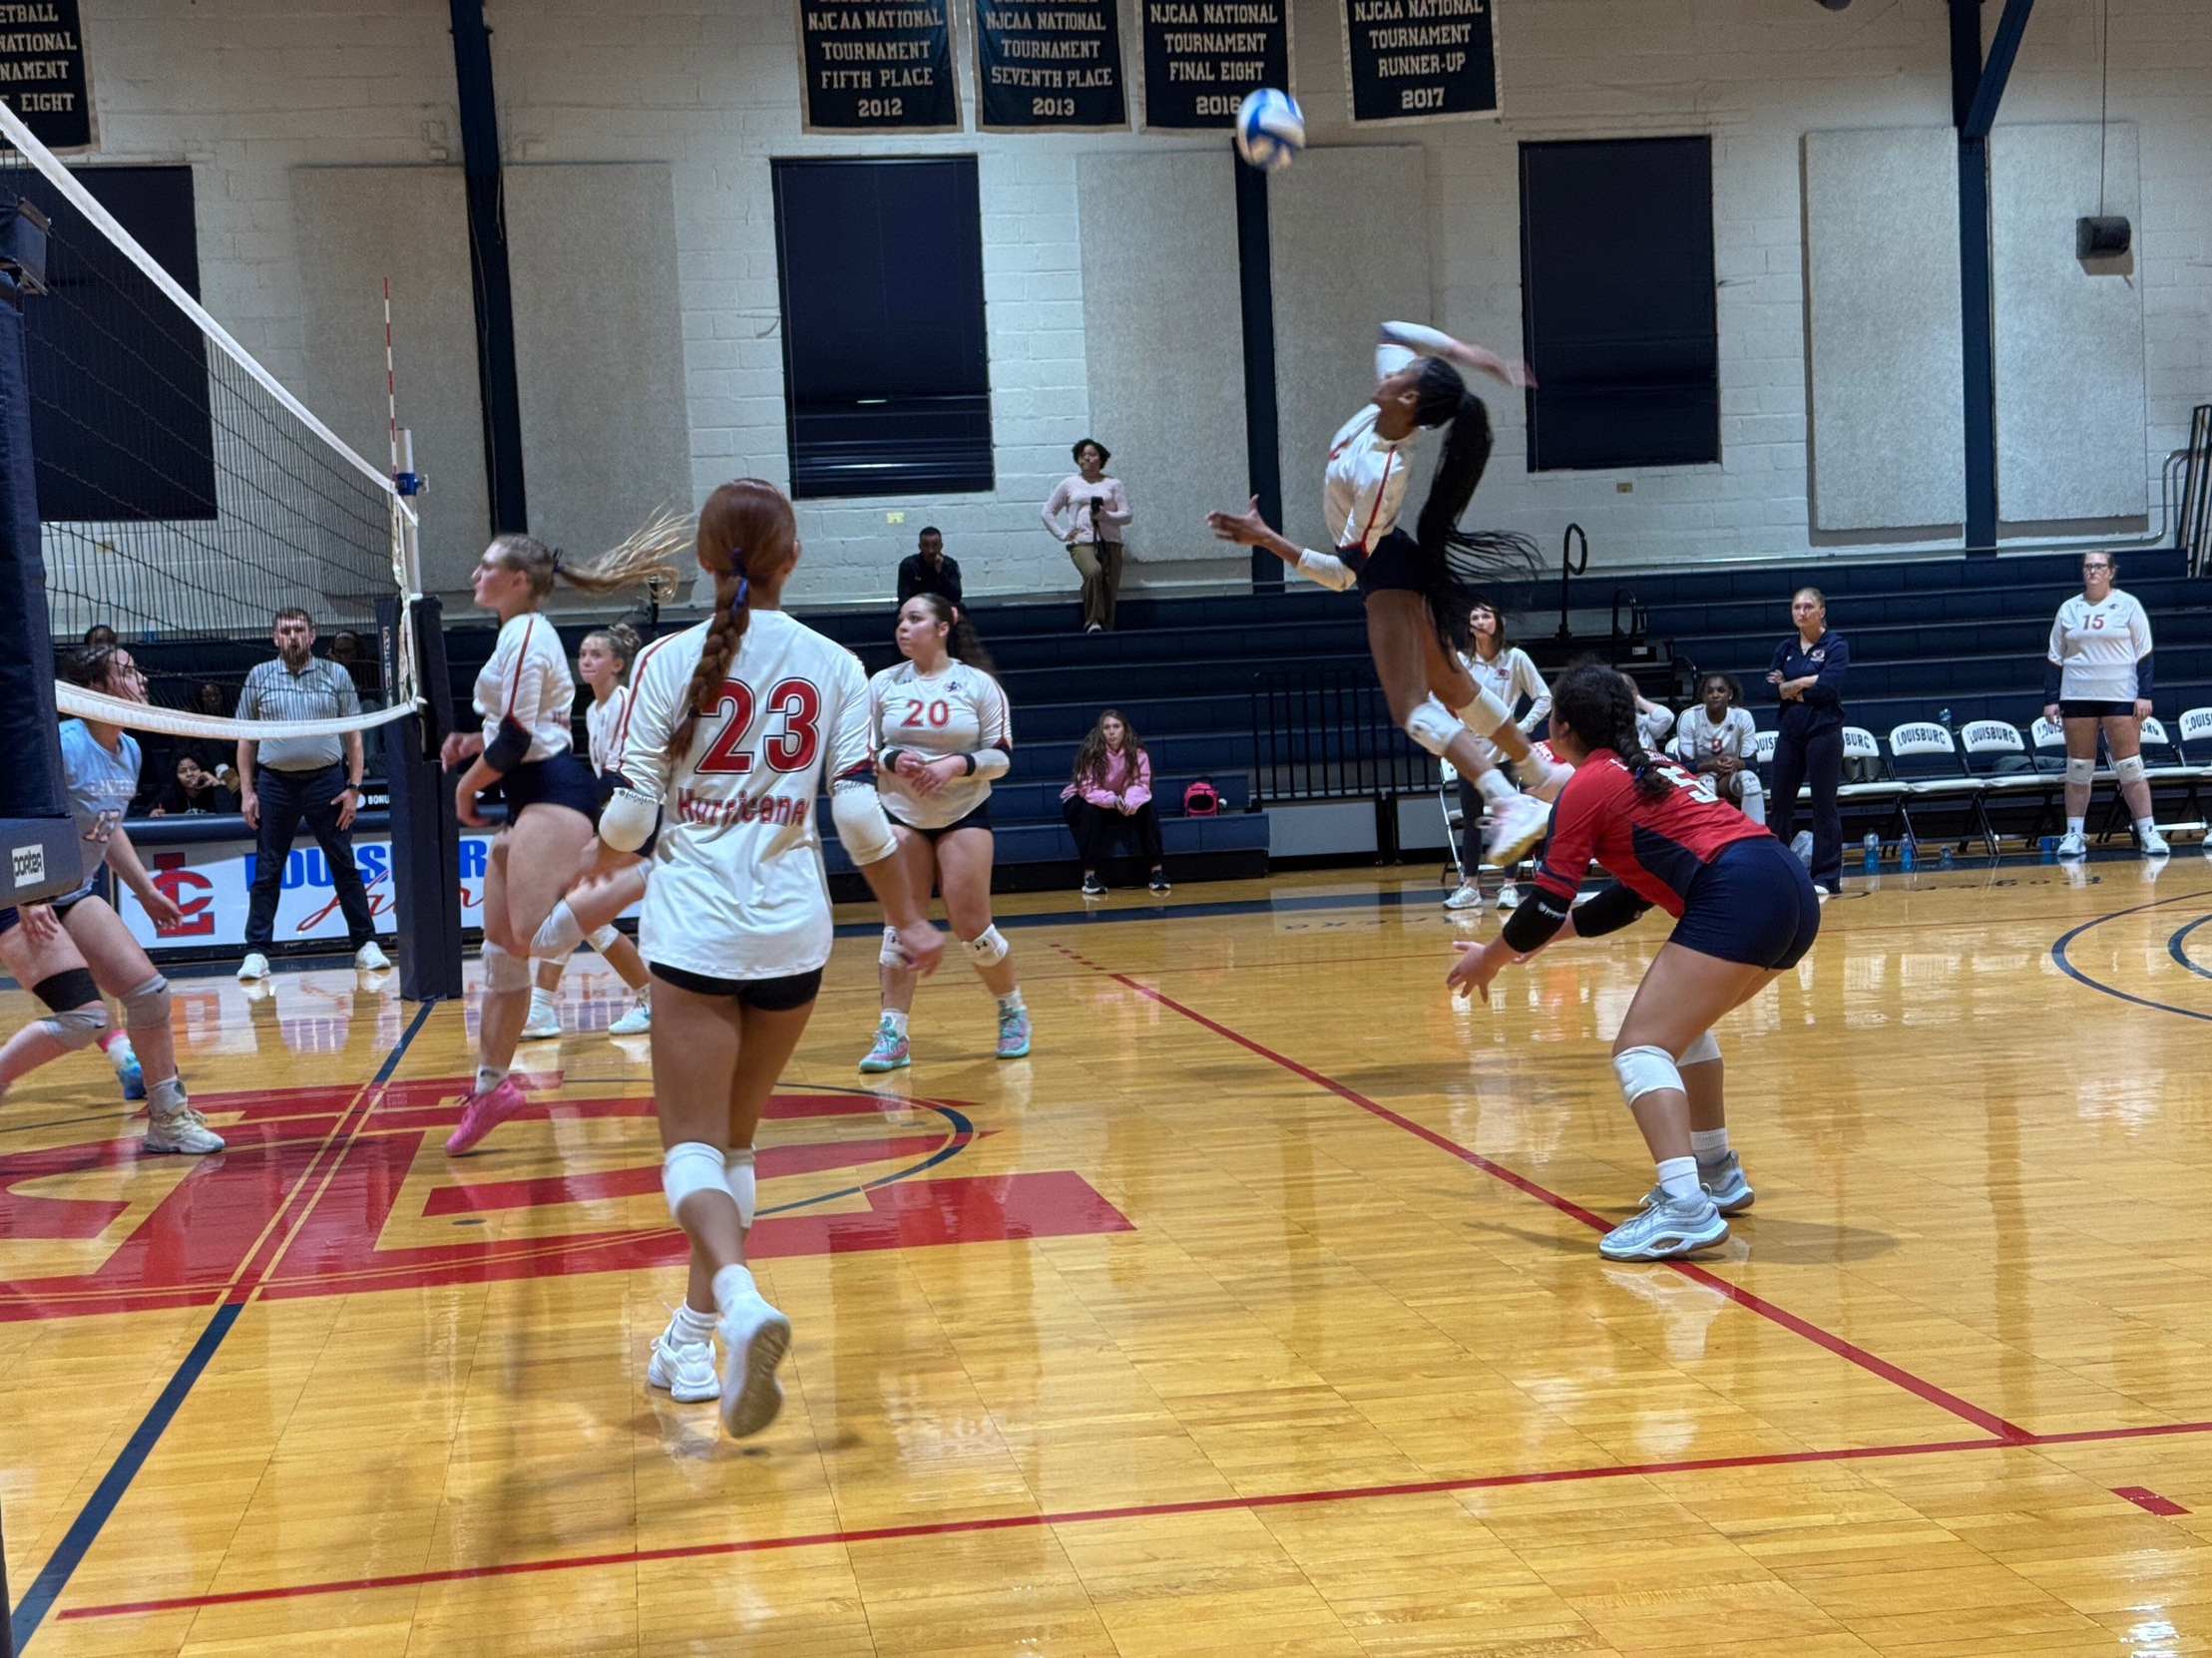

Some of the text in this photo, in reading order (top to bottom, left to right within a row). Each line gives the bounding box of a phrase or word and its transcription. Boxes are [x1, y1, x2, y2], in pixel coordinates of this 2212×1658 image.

[808, 8, 944, 31] NJCAA NATIONAL
[985, 11, 1106, 31] NJCAA NATIONAL
[1150, 3, 1278, 24] NJCAA NATIONAL
[1354, 0, 1484, 22] NJCAA NATIONAL
[1164, 33, 1267, 54] TOURNAMENT
[1369, 23, 1472, 50] TOURNAMENT
[821, 40, 931, 61] TOURNAMENT
[1001, 39, 1101, 59] TOURNAMENT
[1169, 62, 1264, 82] FINAL EIGHT
[1378, 52, 1467, 78] RUNNER-UP
[821, 68, 933, 90] FIFTH PLACE
[992, 66, 1112, 88] SEVENTH PLACE
[21, 92, 75, 112] EIGHT
[858, 98, 903, 118] 2012
[1033, 98, 1075, 116] 2013
[1195, 96, 1242, 115] 2016
[1401, 87, 1445, 109] 2017
[2082, 614, 2105, 630] 15
[900, 699, 950, 727] 20
[693, 676, 821, 774] 23
[1968, 724, 2015, 744] LOUISBURG
[1897, 726, 1947, 747] LOUISBURG
